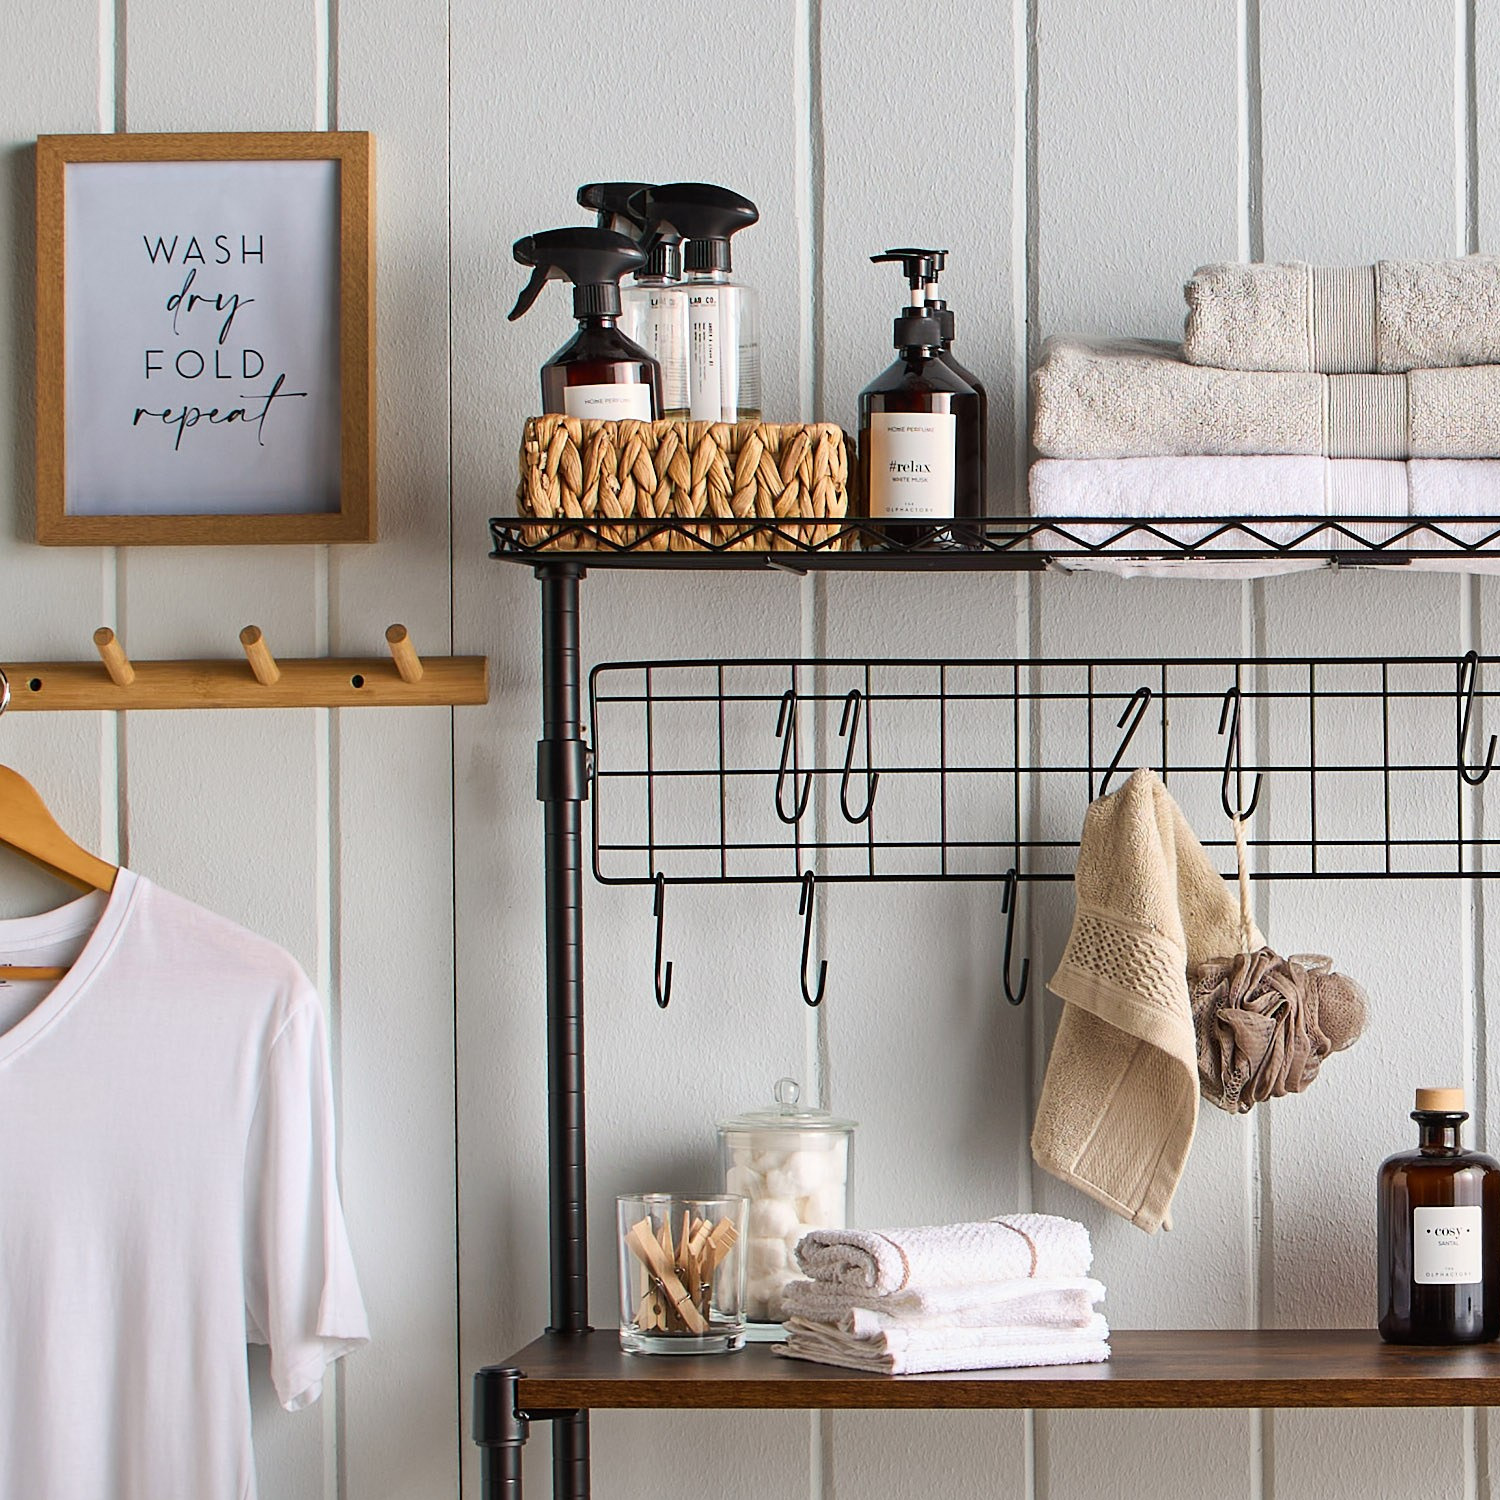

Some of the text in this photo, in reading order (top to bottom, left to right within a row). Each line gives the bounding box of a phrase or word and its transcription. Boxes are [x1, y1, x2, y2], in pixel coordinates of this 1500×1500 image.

[143, 234, 265, 265] WASH
[166, 268, 255, 345] dry
[145, 349, 265, 379] FOLD
[132, 373, 308, 451] repeat
[889, 460, 931, 473] #relax
[1434, 1227, 1463, 1240] cosy
